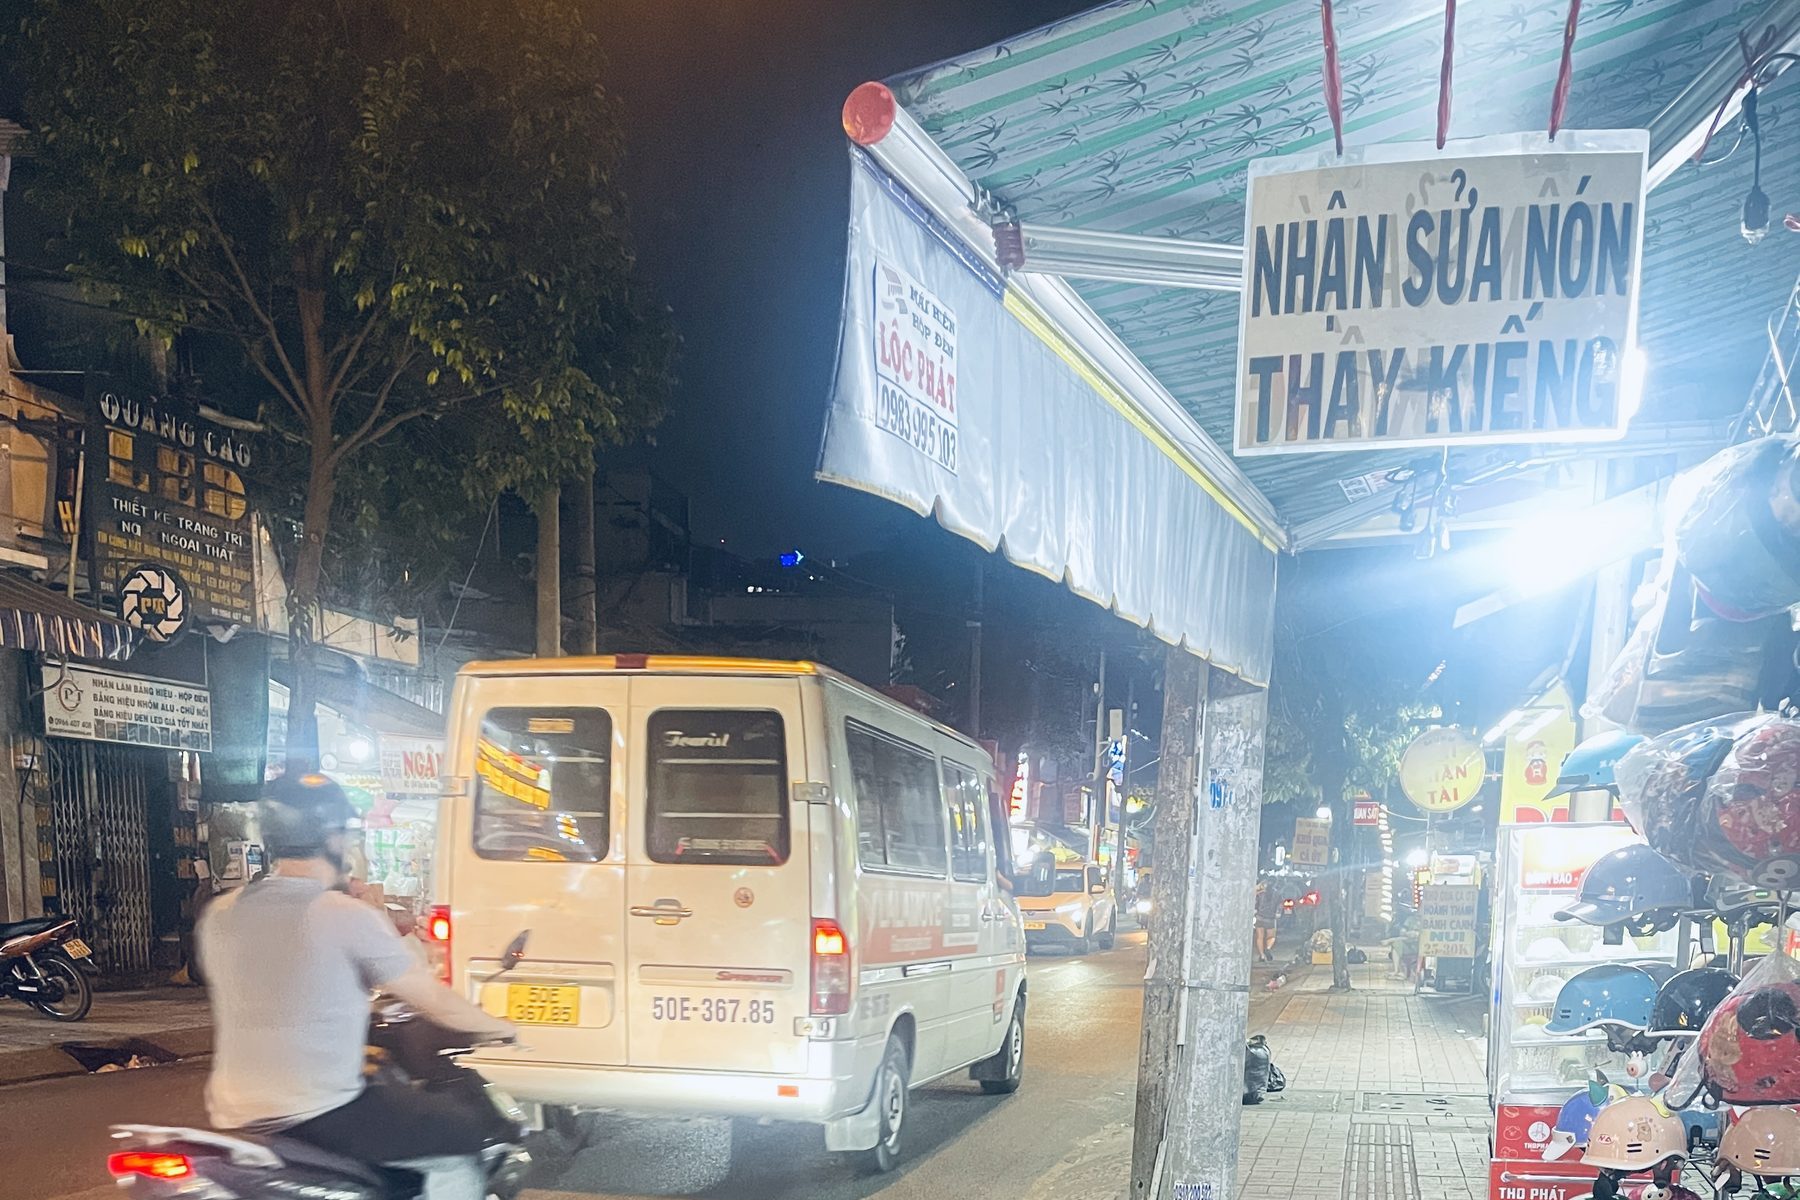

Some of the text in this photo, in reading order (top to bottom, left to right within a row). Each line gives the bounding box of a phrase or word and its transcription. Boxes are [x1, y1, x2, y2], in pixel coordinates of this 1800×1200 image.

[1251, 168, 1633, 331] NHẬN SỬA NÓN
[879, 318, 956, 414] LỘC PHÁT
[1248, 302, 1618, 443] THAY KIẾNG
[881, 383, 956, 472] 0983 995 103
[105, 424, 247, 520] LED
[112, 496, 148, 518] THIẾT
[178, 516, 219, 539] TRANG
[224, 528, 243, 548] TRÍ
[161, 532, 200, 554] NGOẠI
[204, 543, 234, 563] THẤT
[92, 678, 114, 692] NHẬN
[1427, 786, 1459, 805] TÀI
[528, 987, 560, 1004] 50E
[652, 996, 775, 1024] 50E-367.85
[516, 1004, 572, 1022] 367.85
[1529, 1184, 1566, 1200] PHÁT
